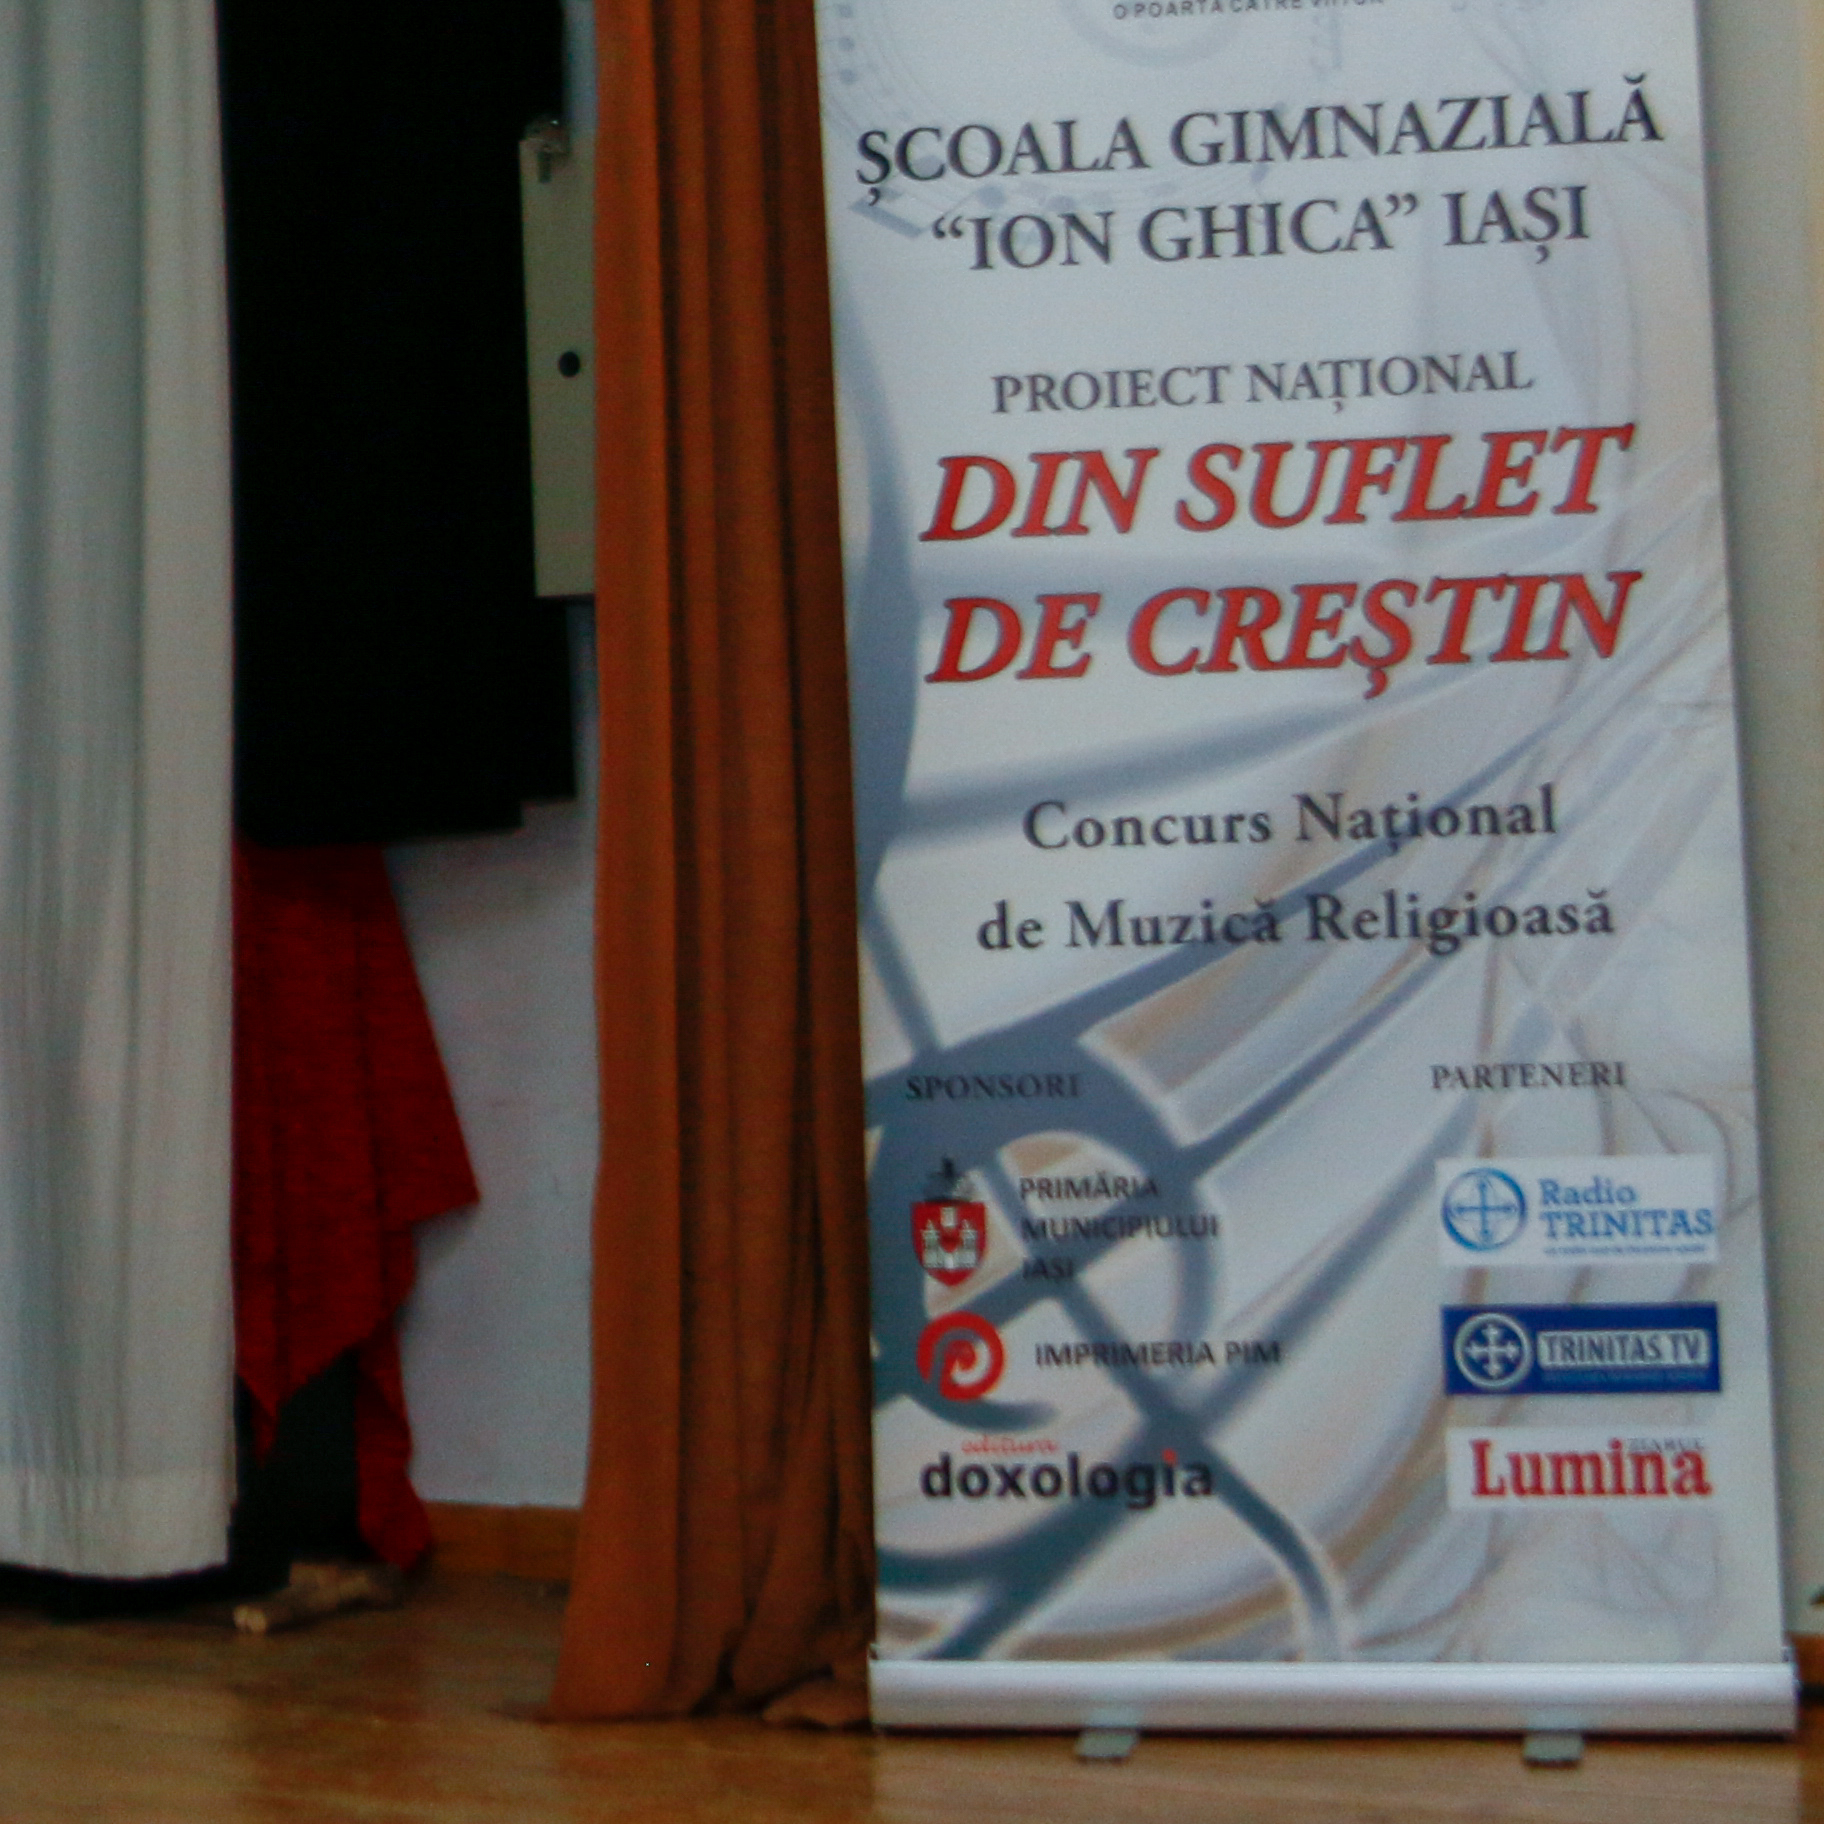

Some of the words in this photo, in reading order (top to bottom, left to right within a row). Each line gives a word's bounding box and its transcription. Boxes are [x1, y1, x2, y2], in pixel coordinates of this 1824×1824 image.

[1113, 3, 1129, 20] O
[856, 114, 1151, 205] ȘCOALA
[1170, 73, 1665, 172] GIMNAZIALĂ
[931, 208, 1116, 273] “ION
[1138, 191, 1418, 267] GHICA”
[1443, 184, 1592, 263] IAȘI
[990, 363, 1231, 415] PROIECT
[1245, 350, 1534, 413] NAȚIONAL
[918, 446, 1160, 543] DIN
[1174, 422, 1636, 531] SUFLET
[924, 591, 1102, 684] DE
[1127, 570, 1644, 700] CREȘTIN
[1021, 798, 1272, 851] Concurs
[1293, 783, 1558, 855] Național
[976, 899, 1045, 952] de
[1066, 893, 1282, 949] Muzică
[1305, 887, 1616, 957] Religioasă
[906, 1073, 1082, 1101] SPONSORI
[1430, 1059, 1628, 1093] PARTENERI
[1019, 1171, 1159, 1200] PRIMĂRIA
[1538, 1176, 1638, 1207] Radio
[1022, 1214, 1220, 1241] MUNICIPIULUI
[1539, 1207, 1715, 1240] TRINITAS
[1035, 1342, 1214, 1367] IMPRIMERIA
[1224, 1340, 1282, 1366] PIM
[1543, 1334, 1661, 1364] TRINITAS
[1670, 1333, 1701, 1361] TV
[920, 1448, 1215, 1510] doxologia
[1470, 1437, 1714, 1500] Lumina
